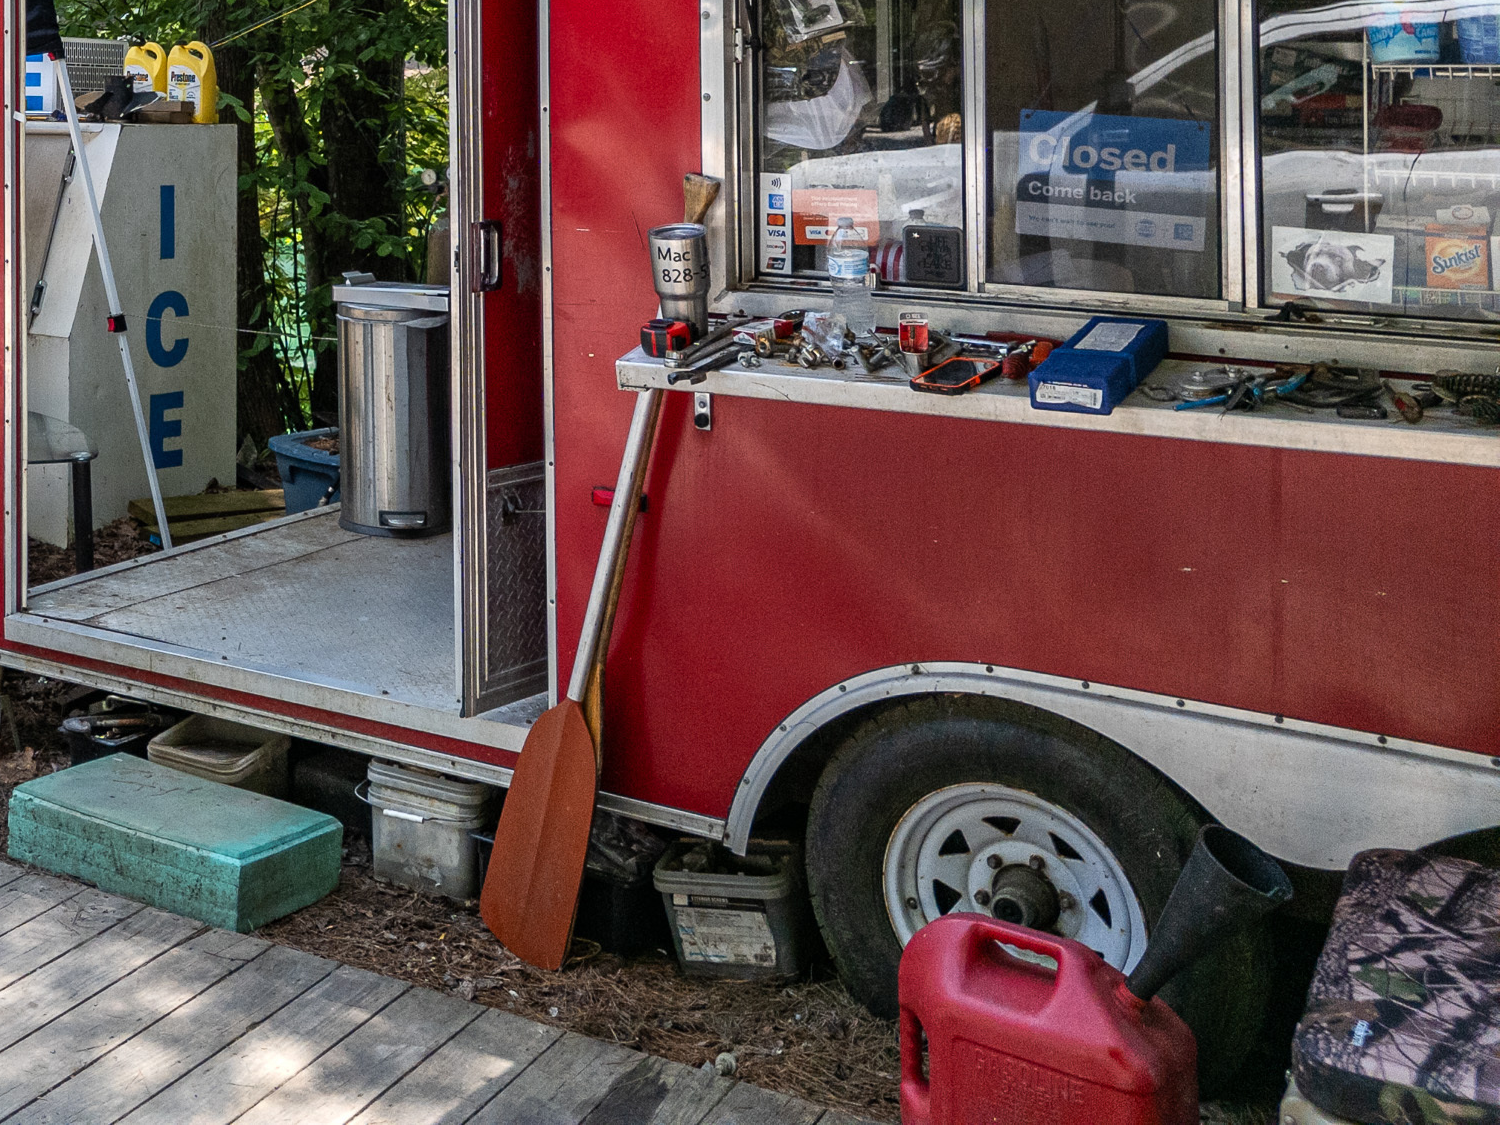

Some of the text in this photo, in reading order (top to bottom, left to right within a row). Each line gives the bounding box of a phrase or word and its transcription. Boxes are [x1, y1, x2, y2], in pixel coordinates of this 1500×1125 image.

[170, 70, 196, 83] Prestone
[1029, 132, 1176, 173] Closed
[1028, 180, 1137, 204] Come back
[767, 229, 787, 238] VISA
[657, 246, 691, 263] Mac
[1432, 244, 1482, 275] Sunkist
[146, 185, 189, 469] ICE
